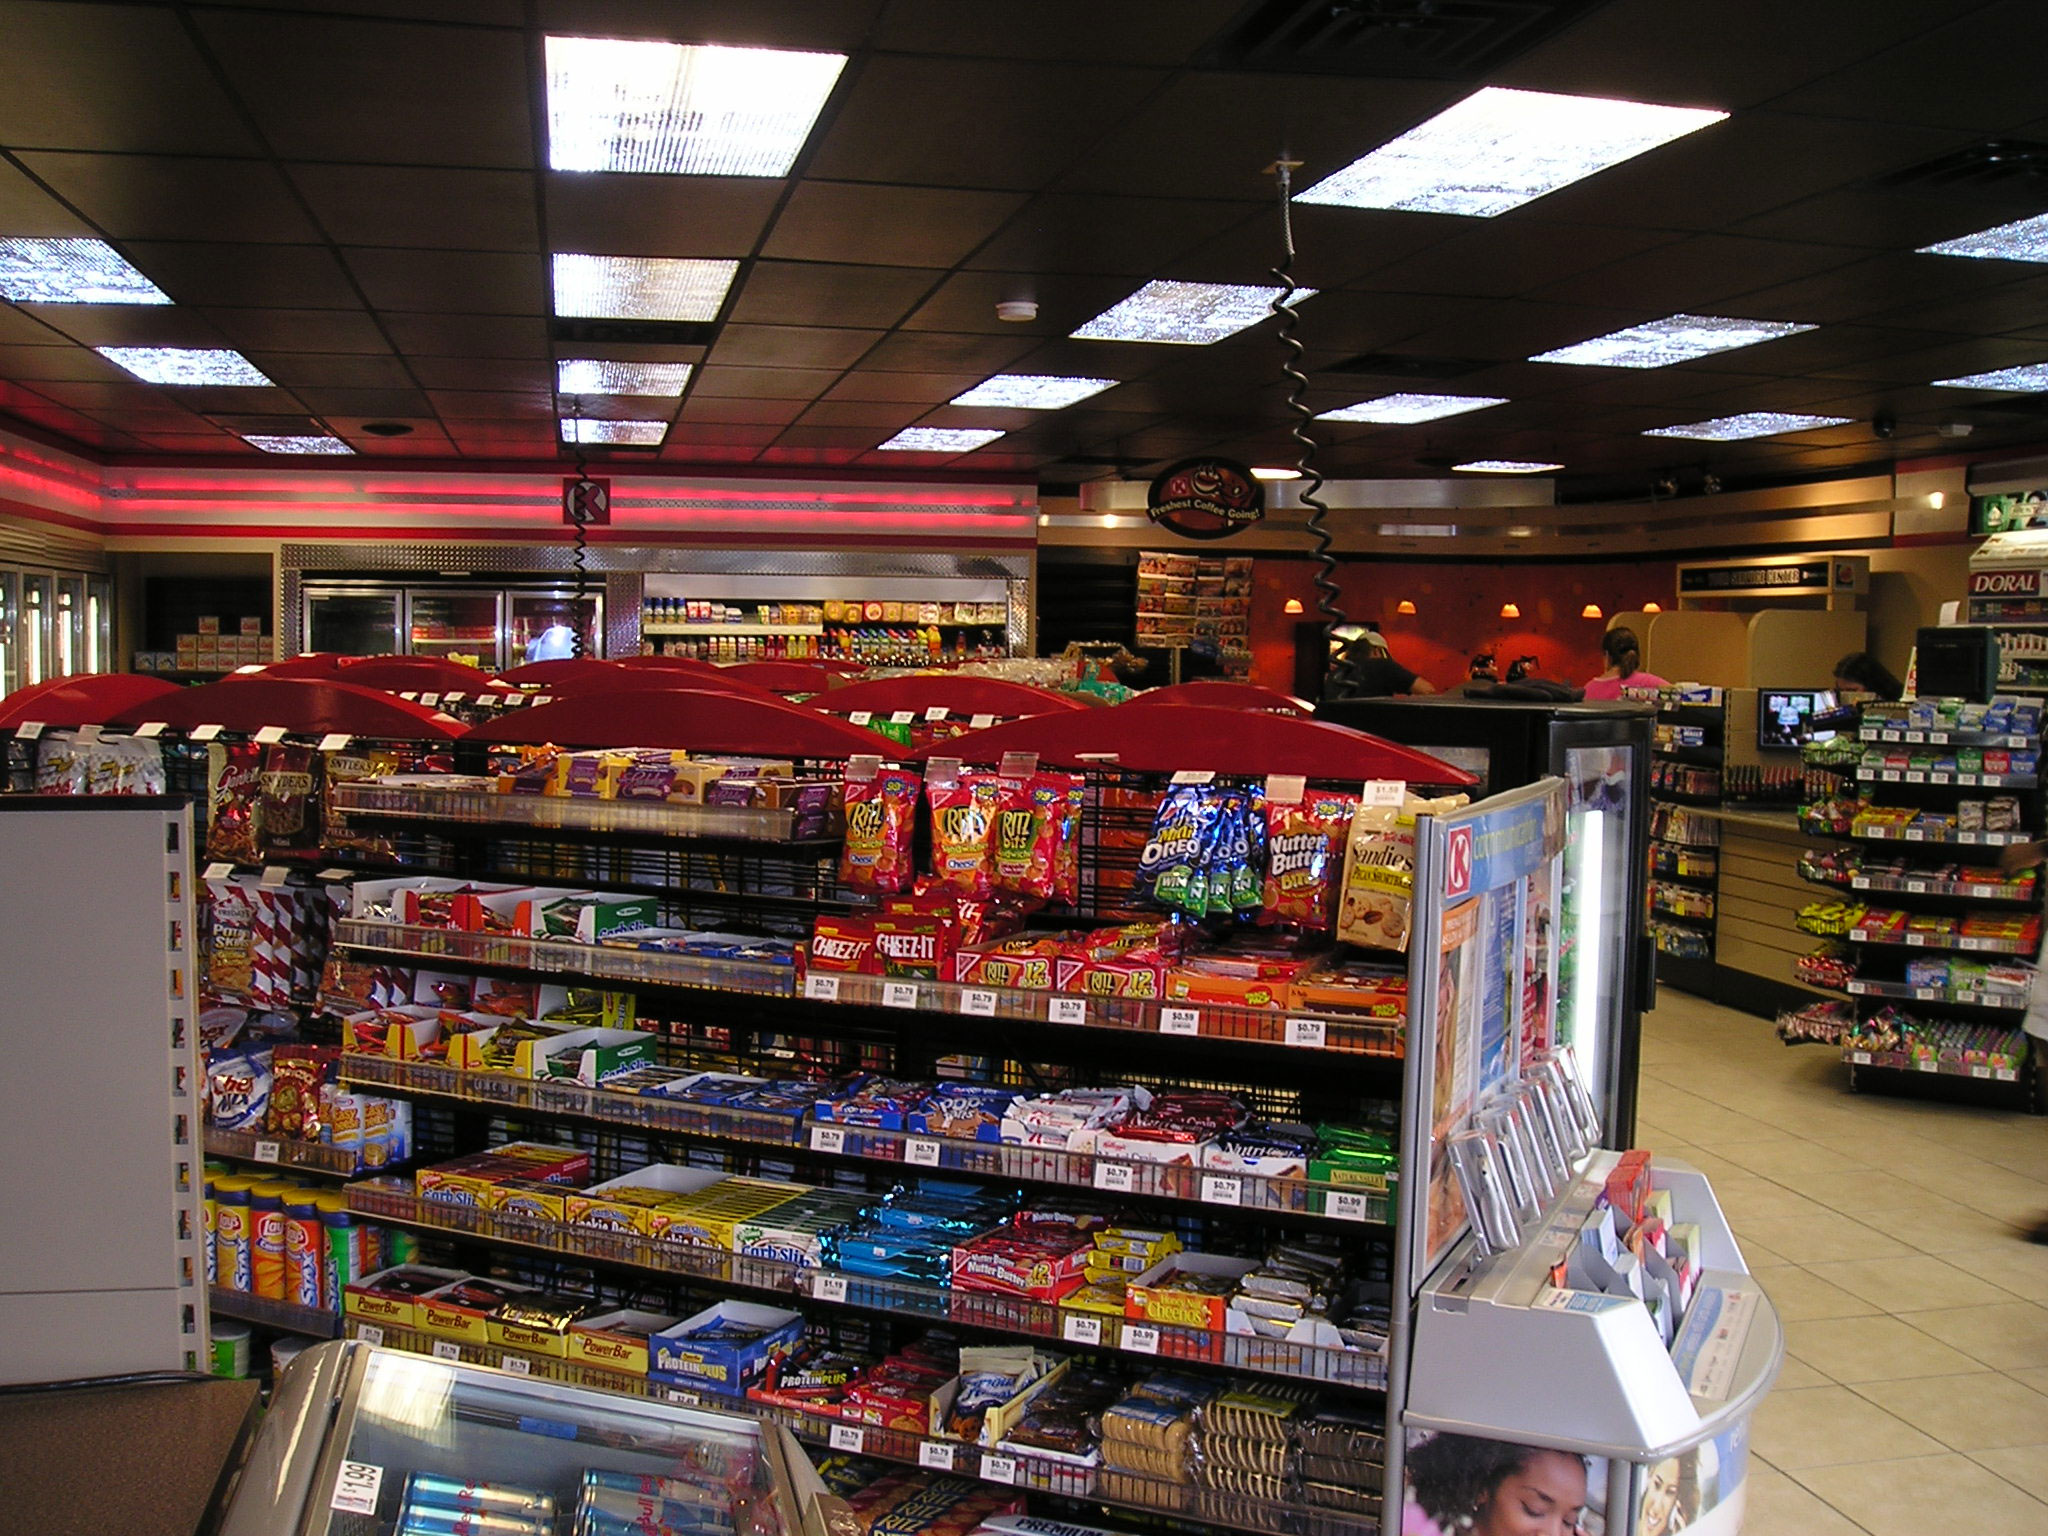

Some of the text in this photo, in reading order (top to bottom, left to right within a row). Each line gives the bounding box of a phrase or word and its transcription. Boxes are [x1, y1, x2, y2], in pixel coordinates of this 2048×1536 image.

[1150, 498, 1260, 521] Freshest Coffee Going!
[1975, 575, 2035, 593] DORAL
[852, 802, 883, 830] RITZ
[1002, 811, 1031, 839] RITZ
[1003, 838, 1027, 850] bits
[1141, 838, 1199, 865] OREO
[1270, 833, 1325, 855] Nutter
[1353, 845, 1414, 872] Sandies
[1162, 876, 1189, 888] WIN
[812, 934, 871, 961] CHEEZ-IT
[875, 933, 936, 960] CHEEZ-IT
[1025, 961, 1047, 979] 12
[815, 979, 835, 989] $0.79
[1130, 971, 1153, 988] 12
[894, 987, 914, 997] $0.79
[972, 994, 993, 1003] $0.79
[1060, 1002, 1082, 1012] $0.79
[1297, 1023, 1321, 1033] $0.79
[820, 1130, 840, 1141] $0.79
[915, 1144, 935, 1154] $0.79
[1106, 1167, 1128, 1178] $0.79
[1213, 1181, 1236, 1192] $0.79
[1337, 1196, 1362, 1207] $0.99
[967, 1260, 1027, 1288] Nutter Butter
[1031, 1263, 1050, 1280] 12
[358, 1296, 401, 1317] PowerBar
[1146, 1301, 1203, 1323] Cheerios
[427, 1309, 472, 1330] PowerBar
[1076, 1320, 1097, 1331] $0.79
[502, 1327, 549, 1347] PowerBar
[1132, 1329, 1154, 1341] $0.99
[583, 1338, 632, 1362] PowerBar
[840, 1429, 859, 1440] $0.79
[929, 1446, 949, 1456] $0.79
[991, 1460, 1011, 1471] $0.79
[914, 1490, 958, 1506] RITZ
[897, 1503, 945, 1520] RITZ
[878, 1514, 925, 1532] RITZ
